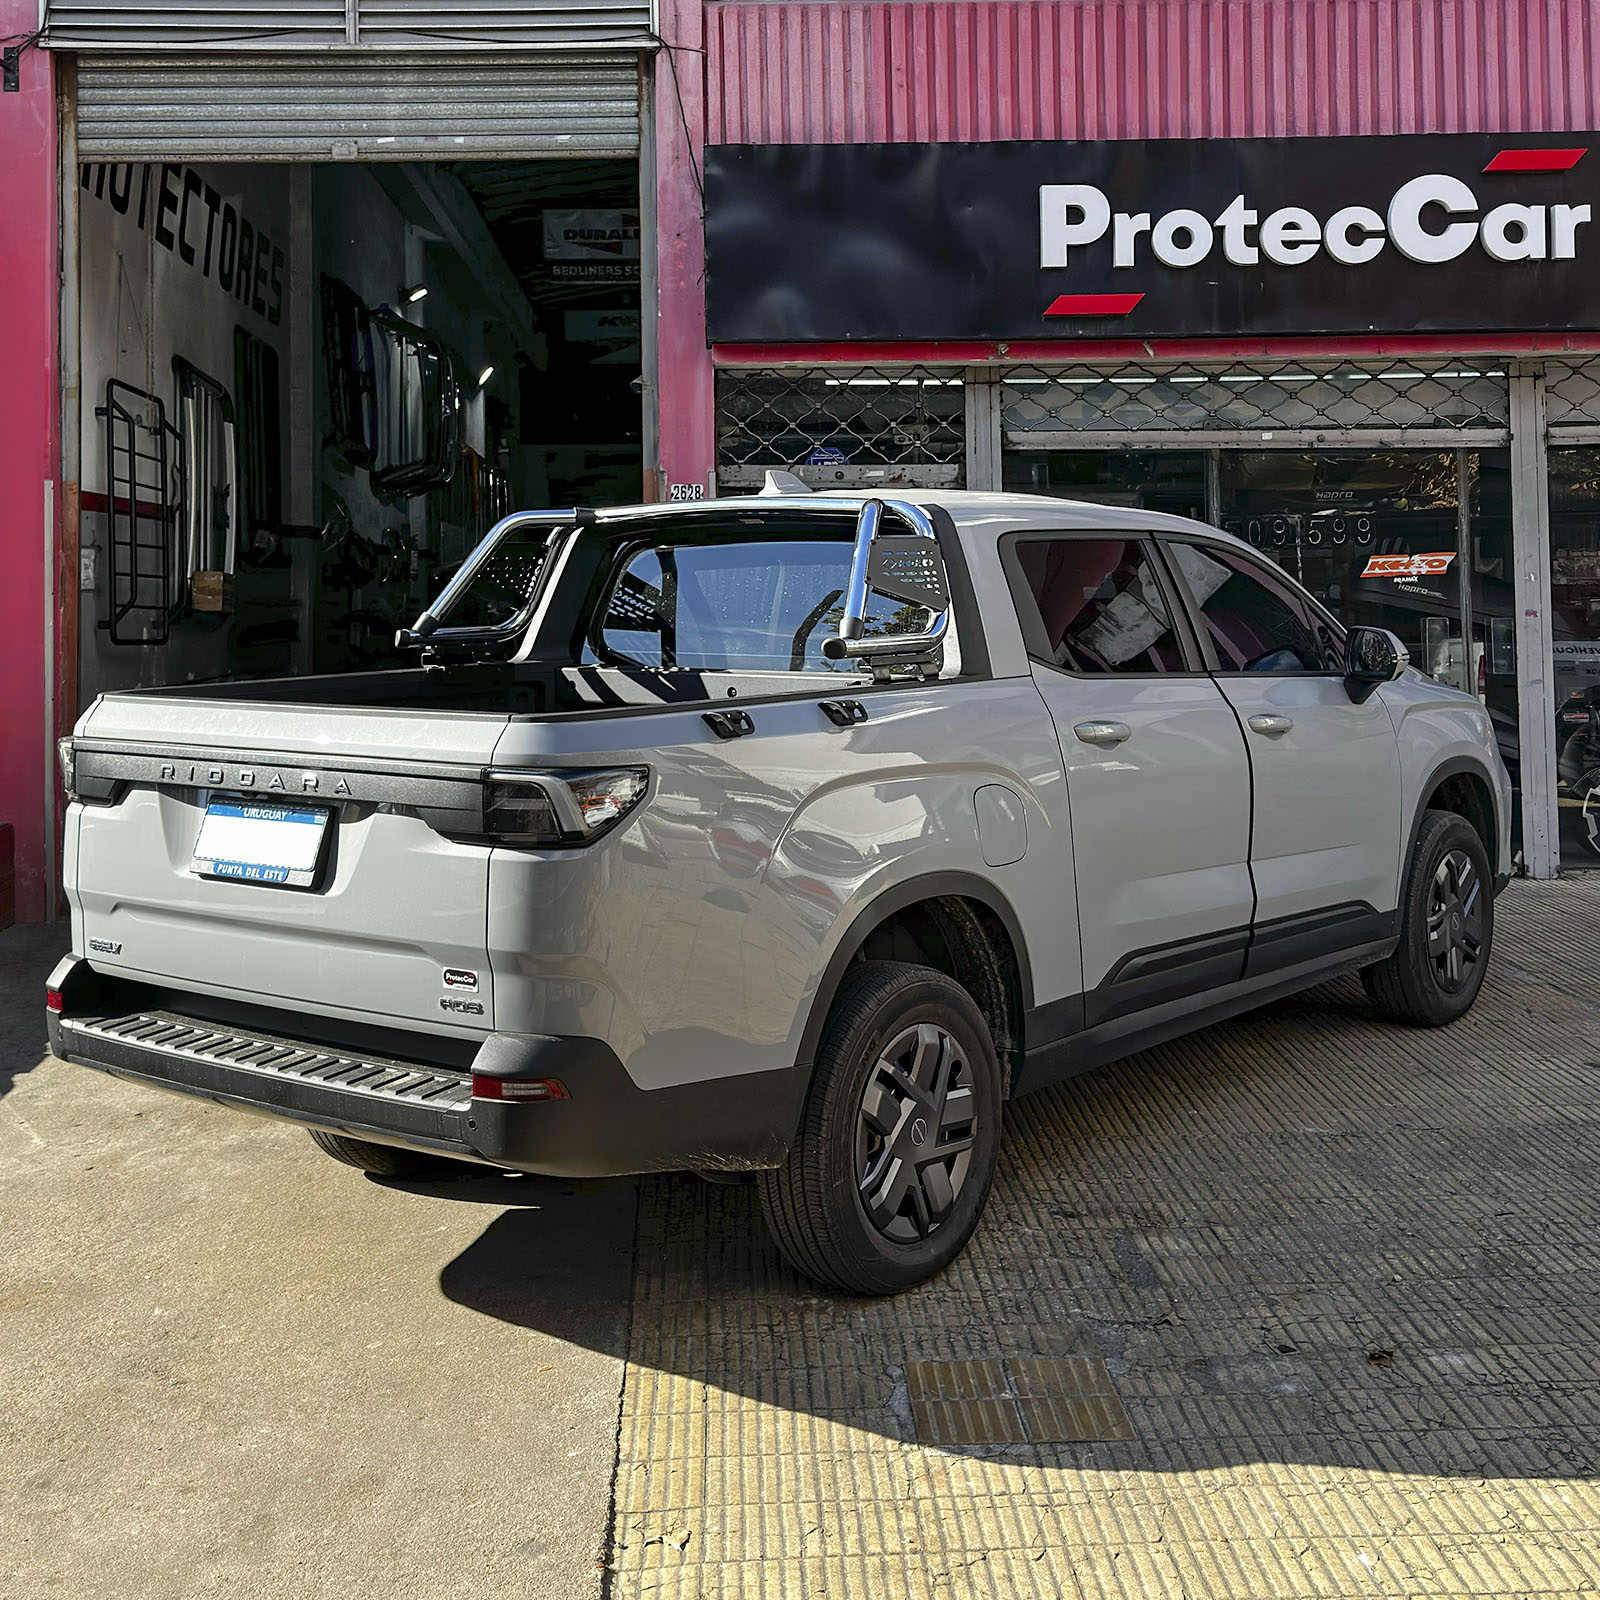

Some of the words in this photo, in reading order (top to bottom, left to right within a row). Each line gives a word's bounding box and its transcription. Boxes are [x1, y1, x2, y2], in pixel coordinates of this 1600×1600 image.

[1040, 173, 1592, 270] ProtecCar
[552, 265, 621, 275] BEDLINERS
[673, 485, 701, 500] 2628
[1308, 517, 1372, 544] 599
[243, 808, 288, 821] URUGUAY
[216, 863, 243, 876] PUNTA
[245, 867, 260, 878] DEL
[264, 869, 284, 881] ESTE
[445, 972, 476, 984] ProtecCar
